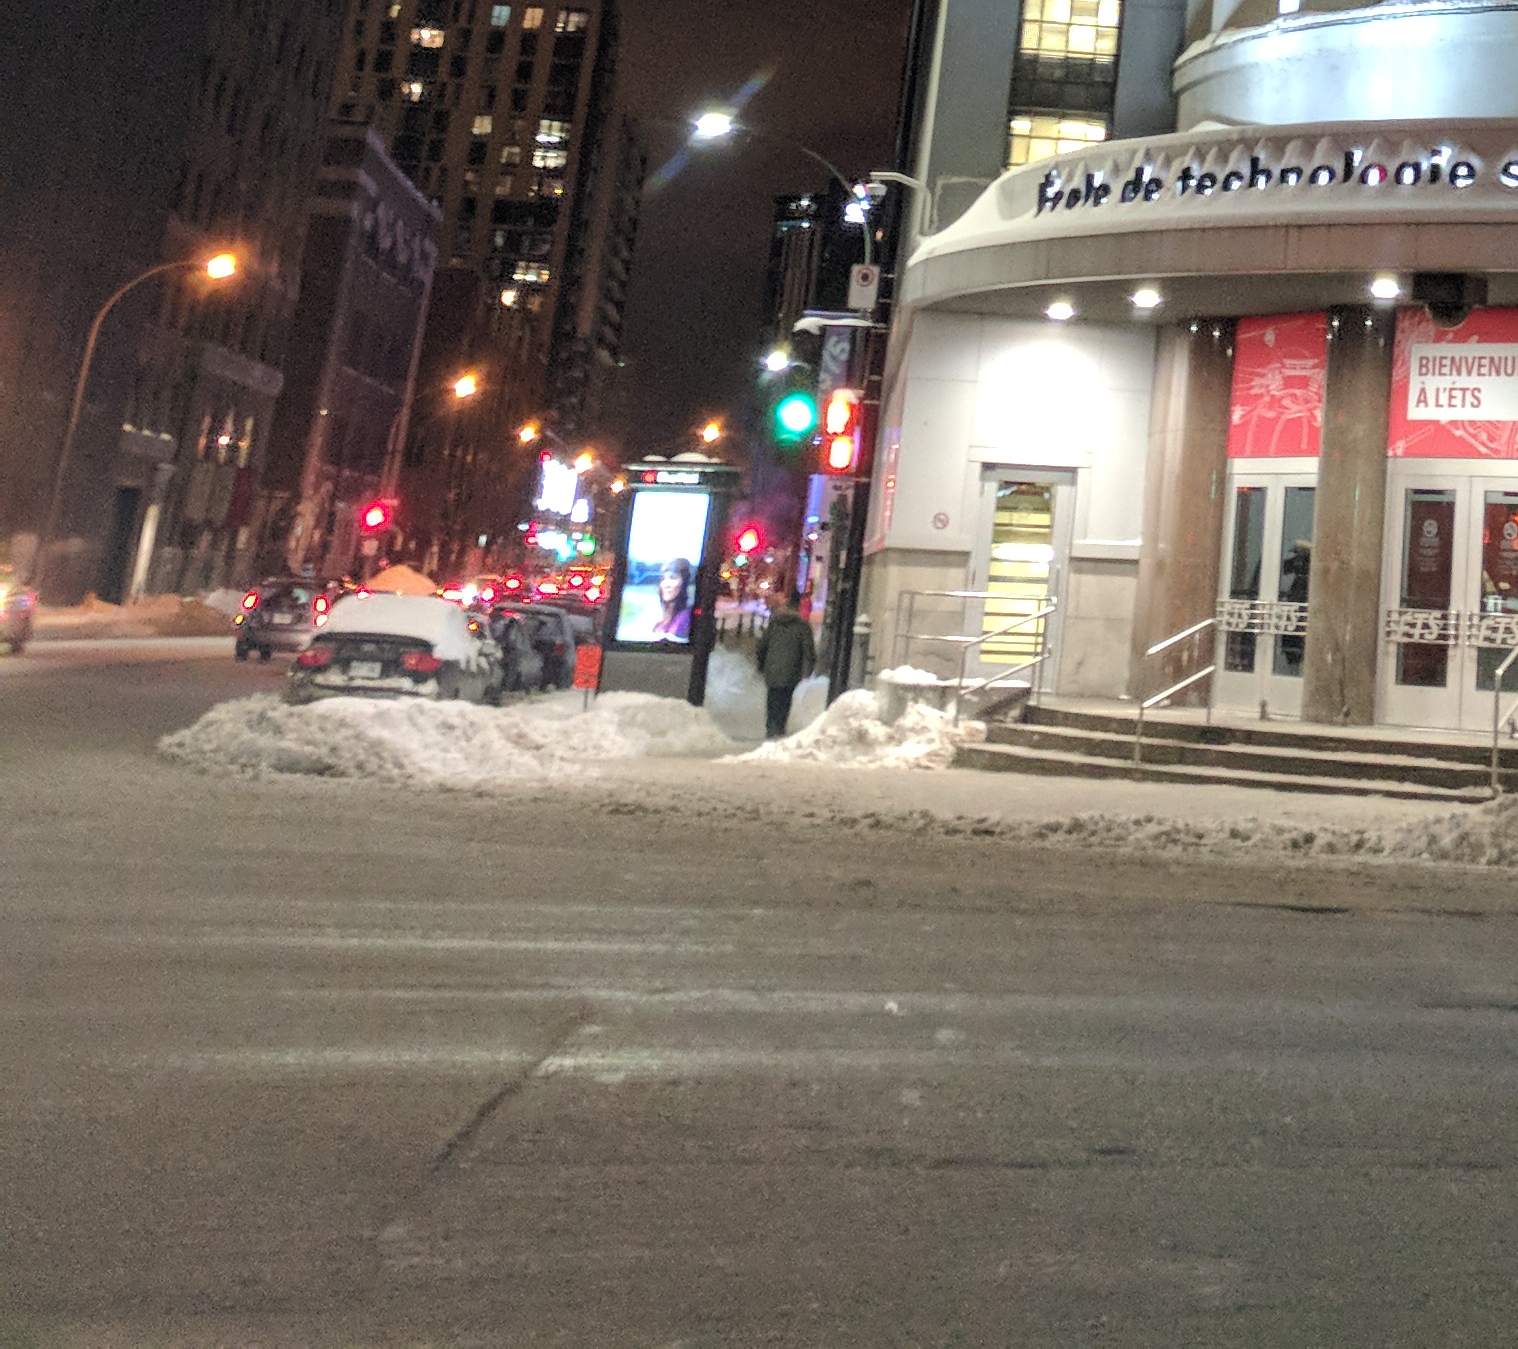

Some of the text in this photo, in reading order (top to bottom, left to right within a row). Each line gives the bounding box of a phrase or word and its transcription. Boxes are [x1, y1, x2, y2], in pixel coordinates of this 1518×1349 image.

[1120, 165, 1163, 202] de
[1415, 381, 1483, 408] À L'ÉTS
